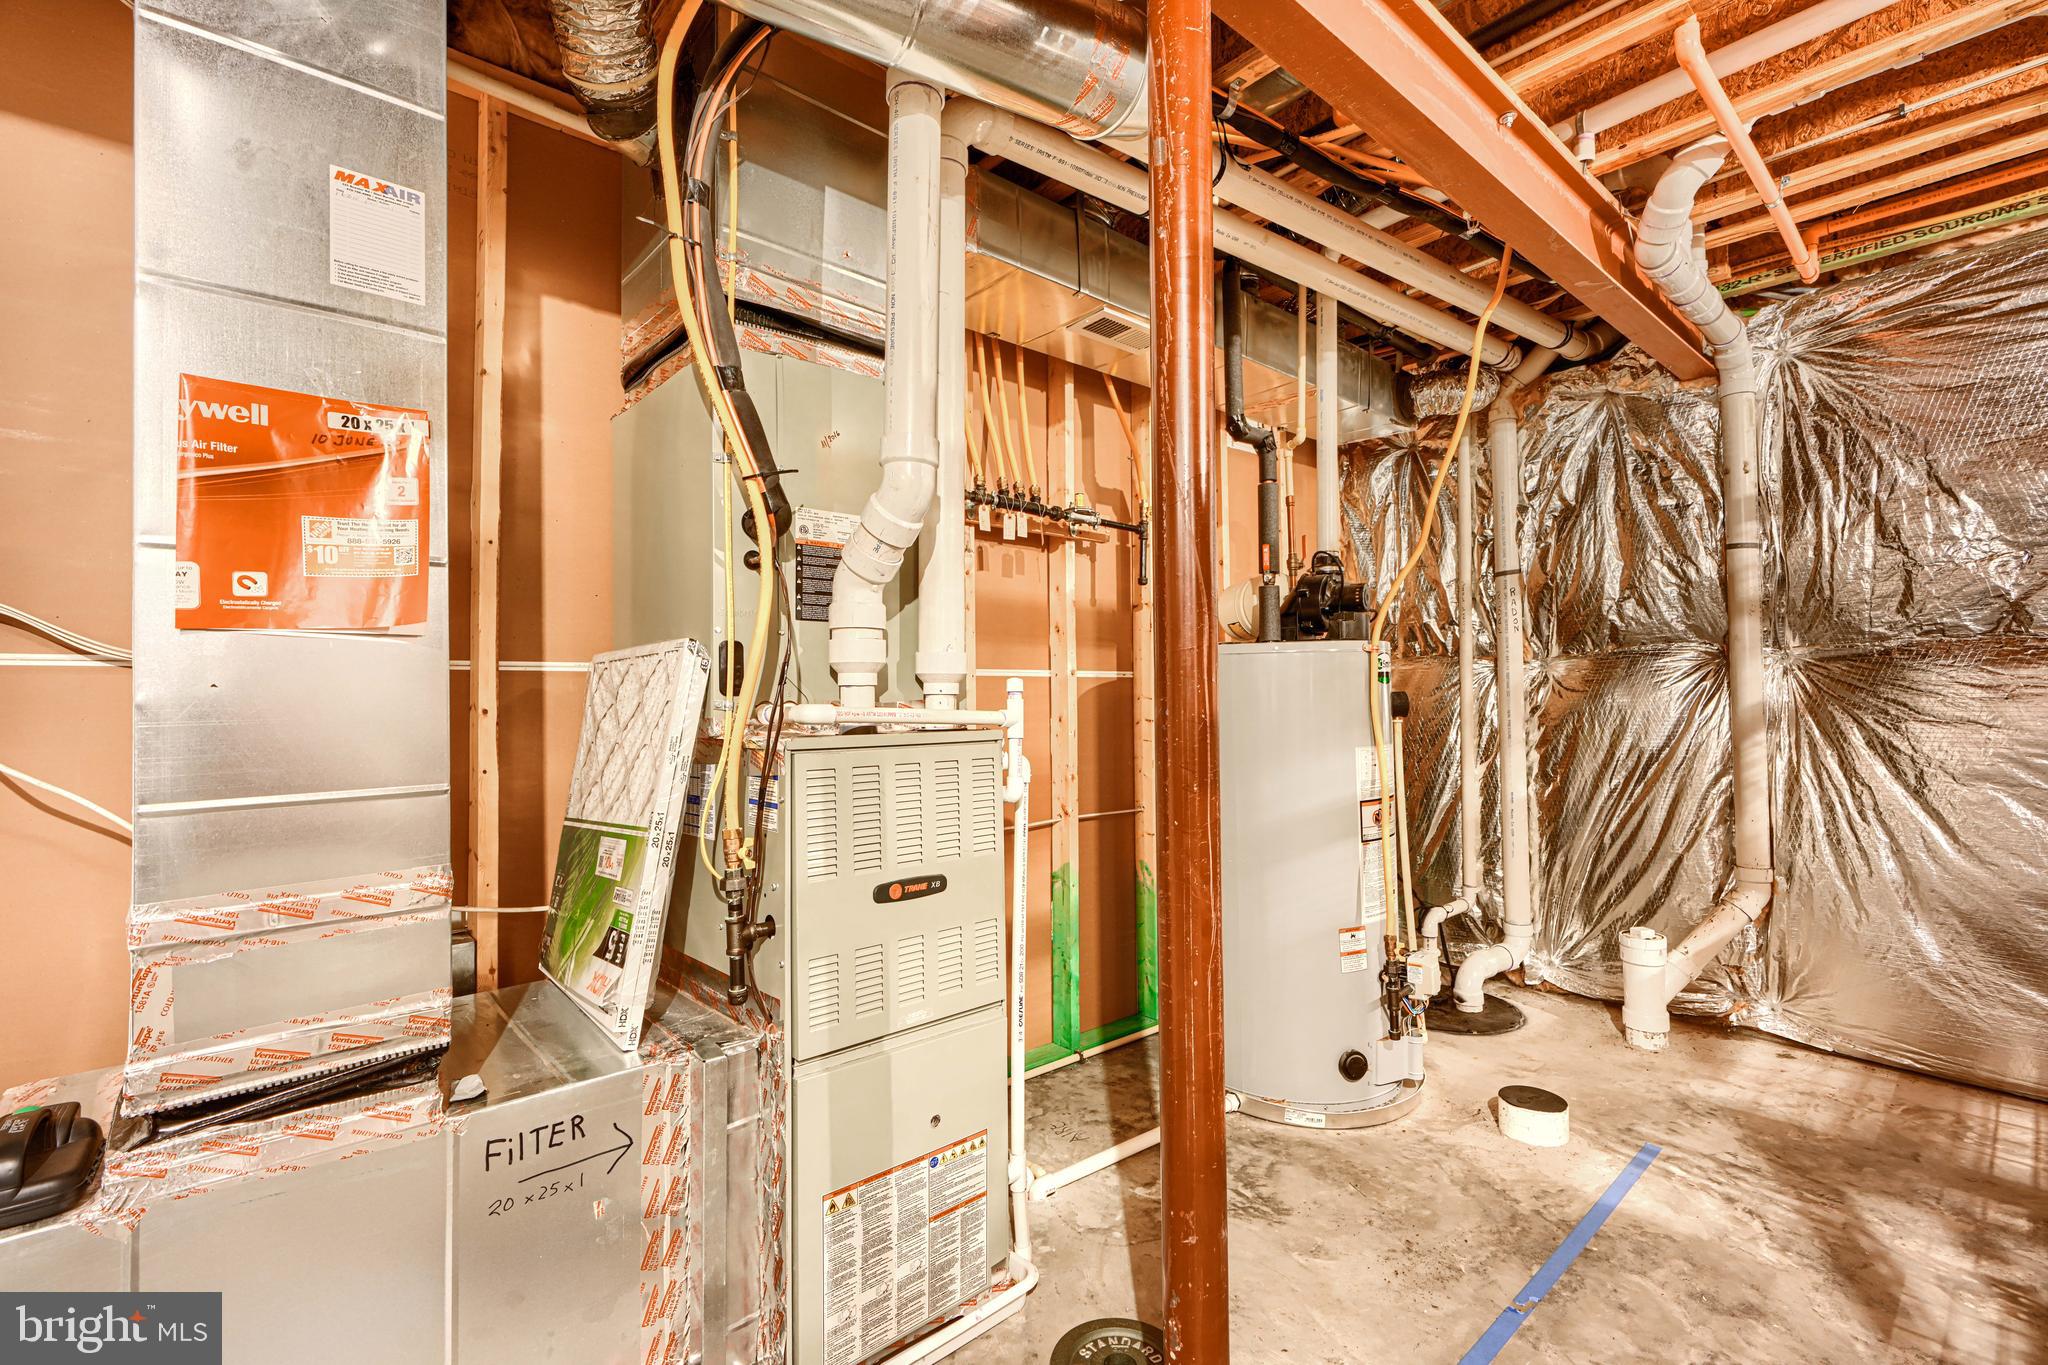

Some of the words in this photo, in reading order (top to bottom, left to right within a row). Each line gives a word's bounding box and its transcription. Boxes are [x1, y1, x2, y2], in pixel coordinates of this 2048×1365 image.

[334, 170, 421, 205] MAXAIR
[1915, 201, 2032, 239] SOURCING
[1820, 235, 1908, 265] ERTIFIED
[177, 400, 269, 427] ywell
[341, 415, 361, 430] 20
[191, 440, 207, 450] Air
[210, 441, 239, 454] Filter
[311, 434, 329, 445] 10
[332, 434, 375, 447] JUNE
[398, 485, 406, 497] 2
[1509, 586, 1520, 633] RADON
[135, 990, 152, 1014] 1581A
[618, 1006, 629, 1028] HDX
[628, 1025, 639, 1046] HDX
[488, 1197, 515, 1217] 20
[538, 1181, 561, 1201] 25
[1078, 1336, 1164, 1365] STANDARD
